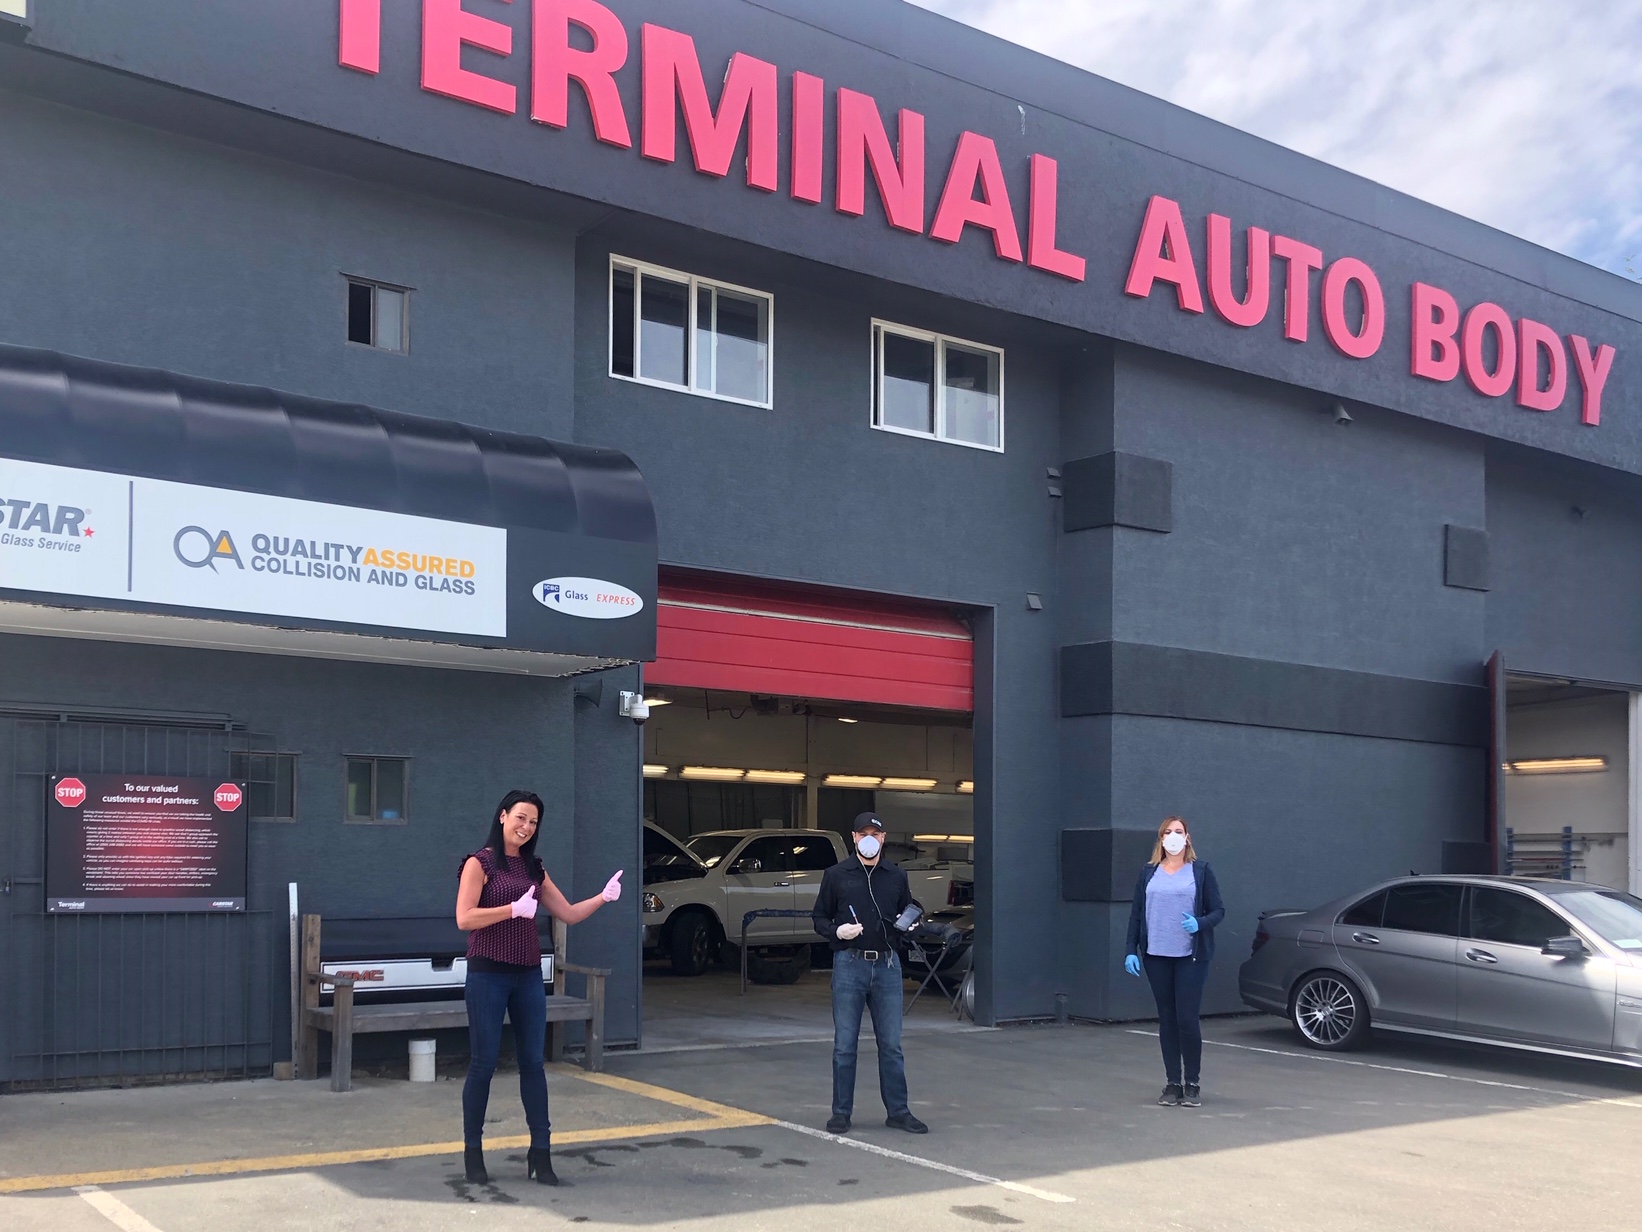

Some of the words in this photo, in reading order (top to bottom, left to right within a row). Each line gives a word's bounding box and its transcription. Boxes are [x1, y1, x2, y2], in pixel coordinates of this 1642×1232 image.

[1125, 195, 1386, 358] AUTO
[1411, 283, 1616, 426] BODY
[1, 533, 35, 548] Glass
[37, 537, 82, 553] Service
[251, 555, 360, 584] COLLISION
[367, 569, 408, 588] AND
[414, 574, 477, 596] GLASS
[565, 590, 589, 601] Glass
[597, 594, 635, 605] EXPRESS
[57, 788, 83, 798] STOP
[124, 784, 135, 792] To
[151, 785, 179, 793] valued
[102, 796, 145, 804] customers
[163, 798, 199, 806] partners:
[216, 793, 239, 802] STOP
